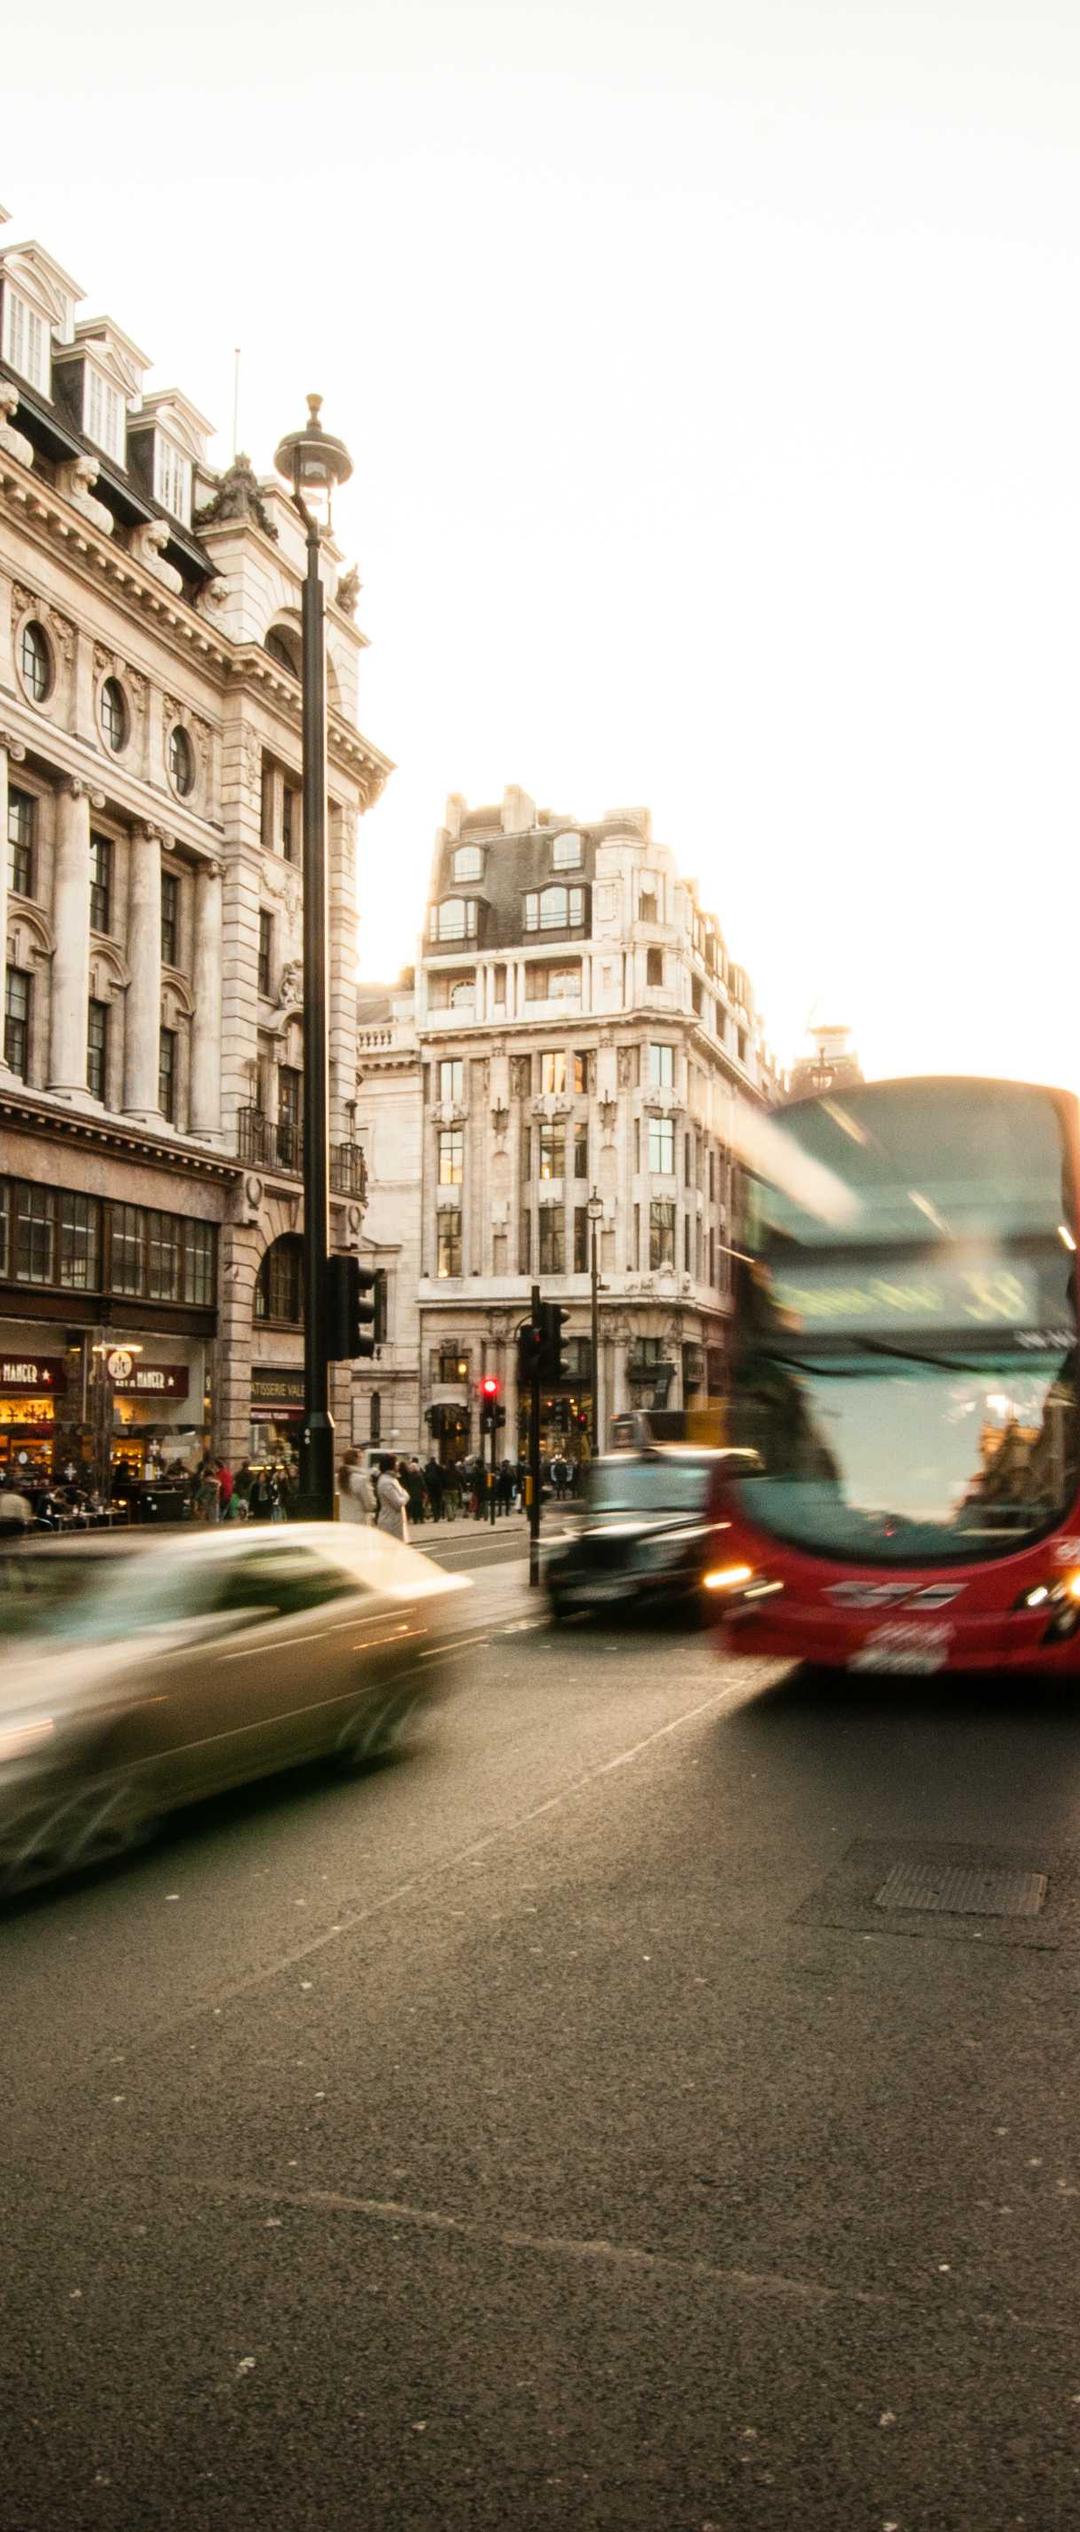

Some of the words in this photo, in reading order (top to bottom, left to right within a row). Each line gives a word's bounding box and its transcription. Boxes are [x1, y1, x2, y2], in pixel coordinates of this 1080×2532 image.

[3, 1363, 38, 1383] MANGER
[136, 1371, 165, 1389] MANGER
[250, 1382, 286, 1397] ATISSERIE
[287, 1383, 305, 1398] VALE
